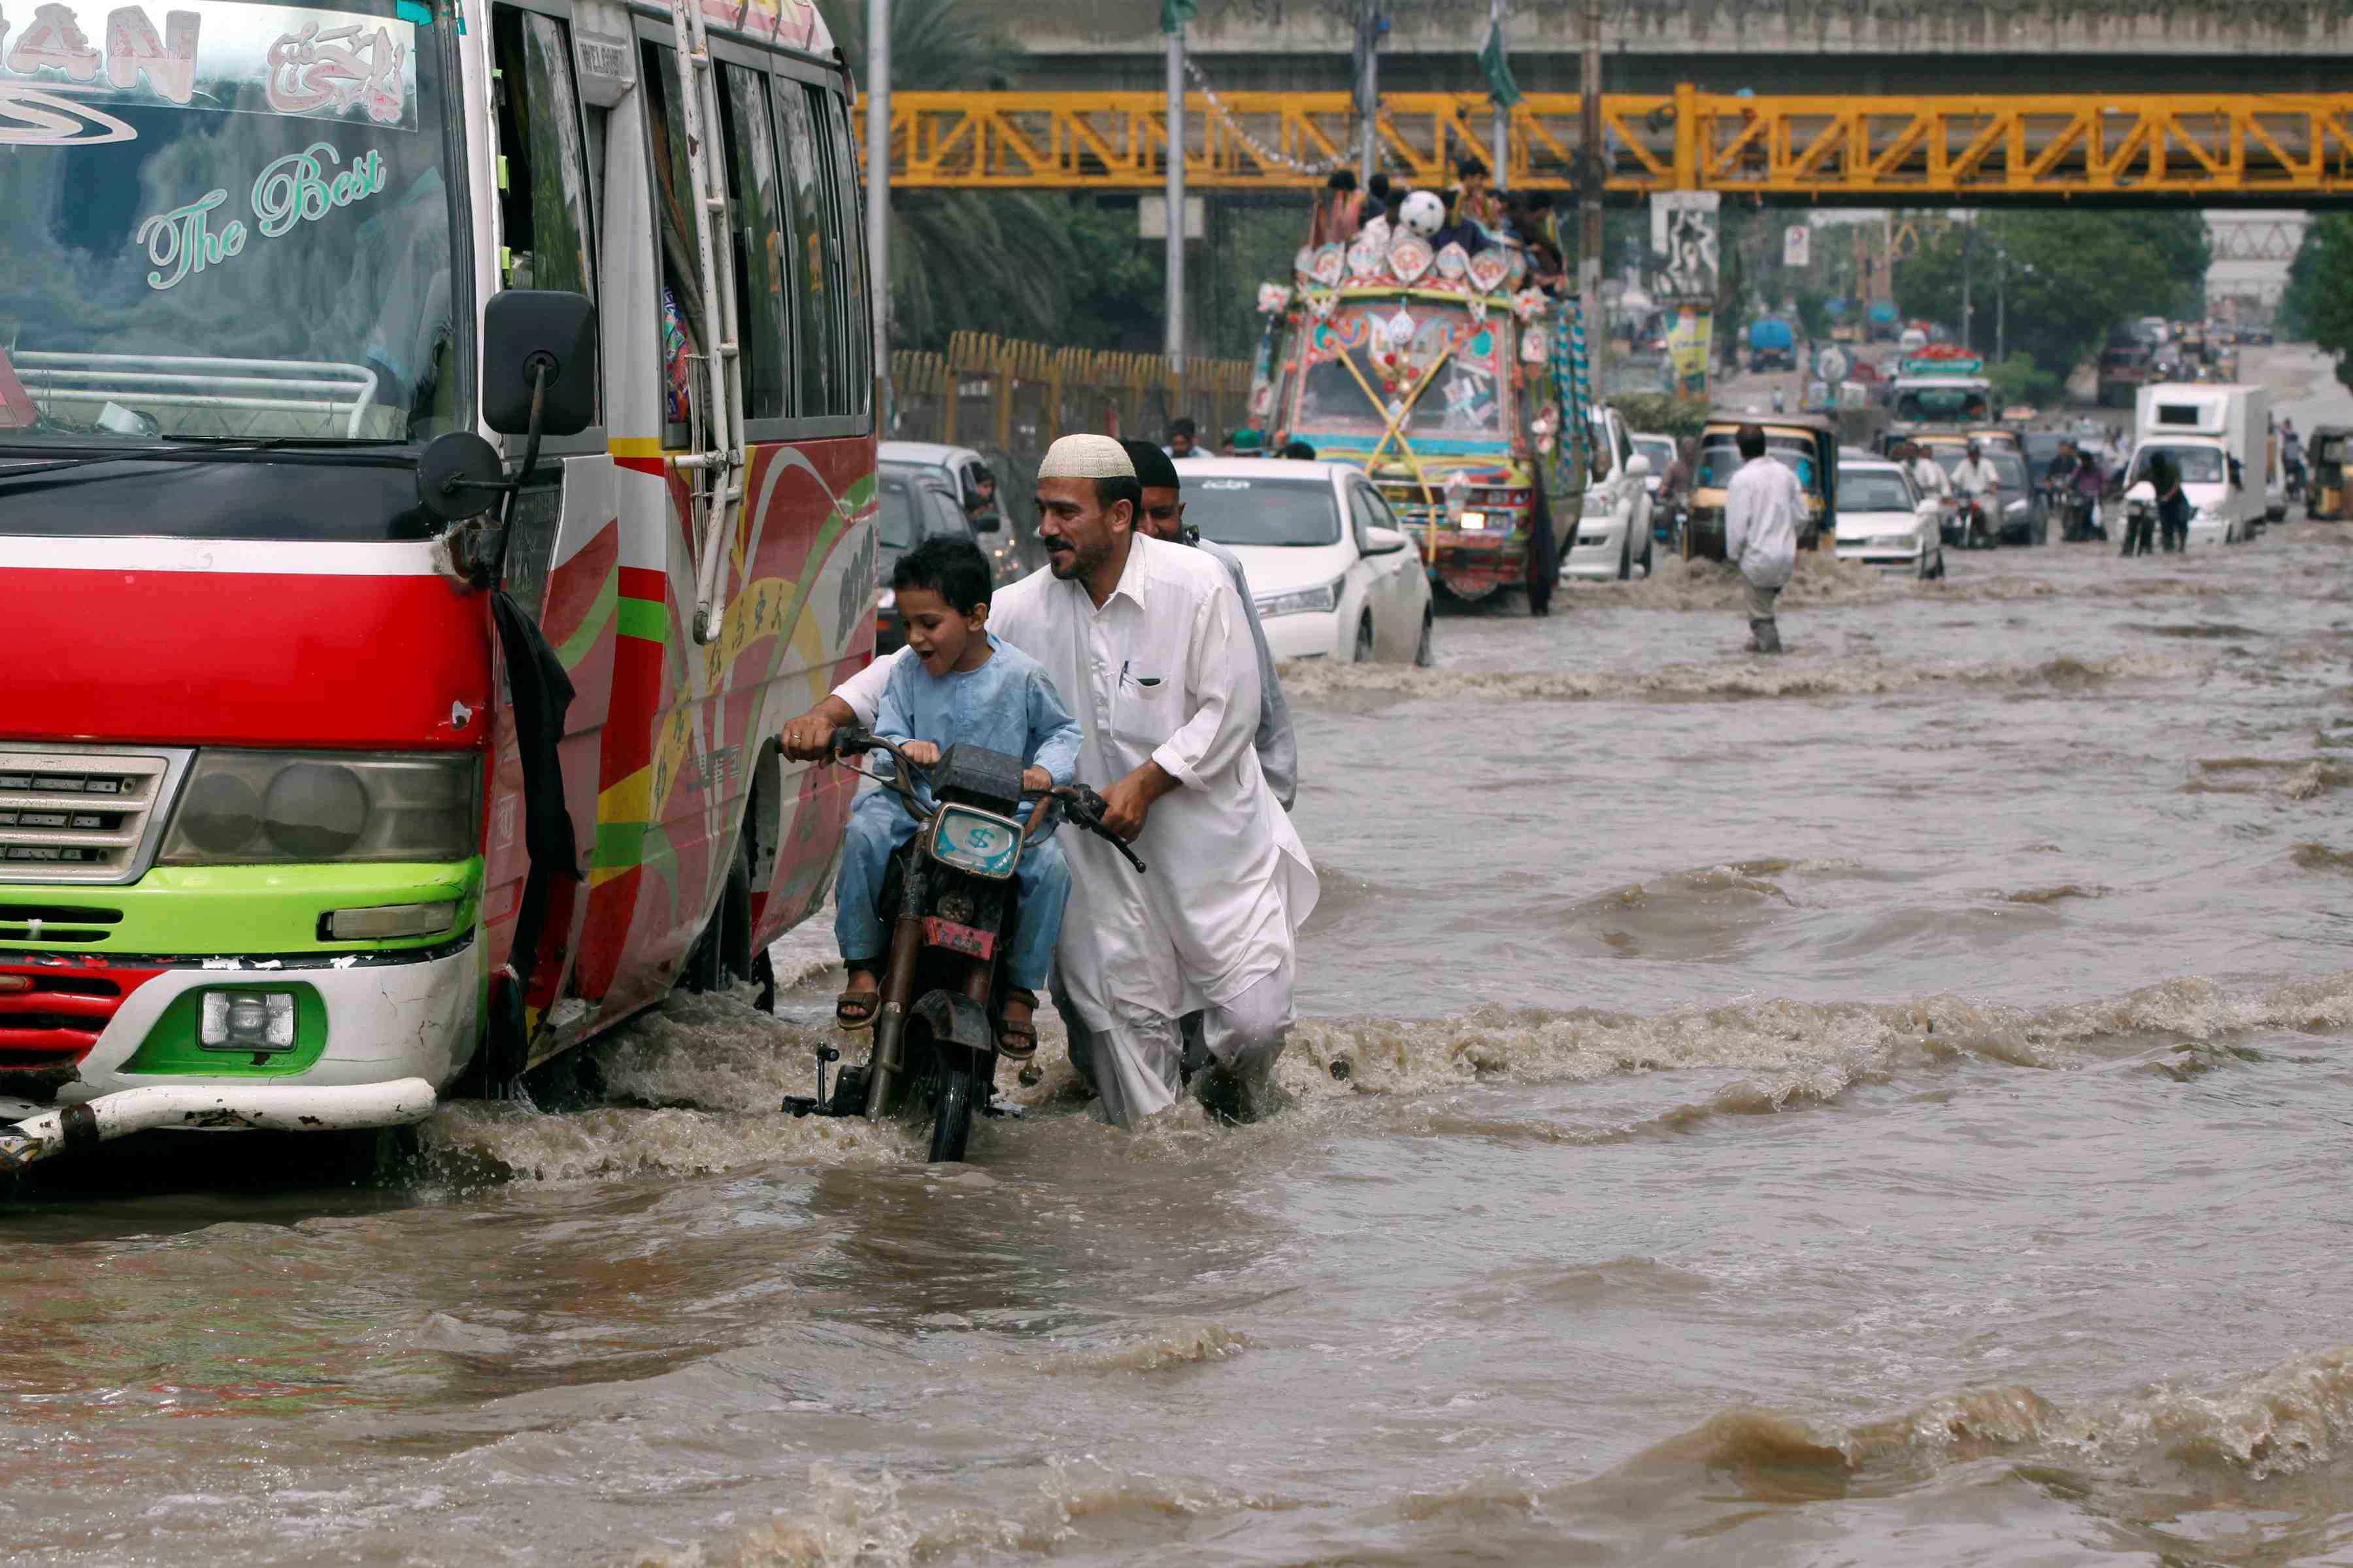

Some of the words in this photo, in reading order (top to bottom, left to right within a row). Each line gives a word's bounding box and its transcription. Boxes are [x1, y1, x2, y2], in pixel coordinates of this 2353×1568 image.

[0, 3, 201, 105] AN
[137, 188, 247, 290] The
[251, 142, 387, 237] Best
